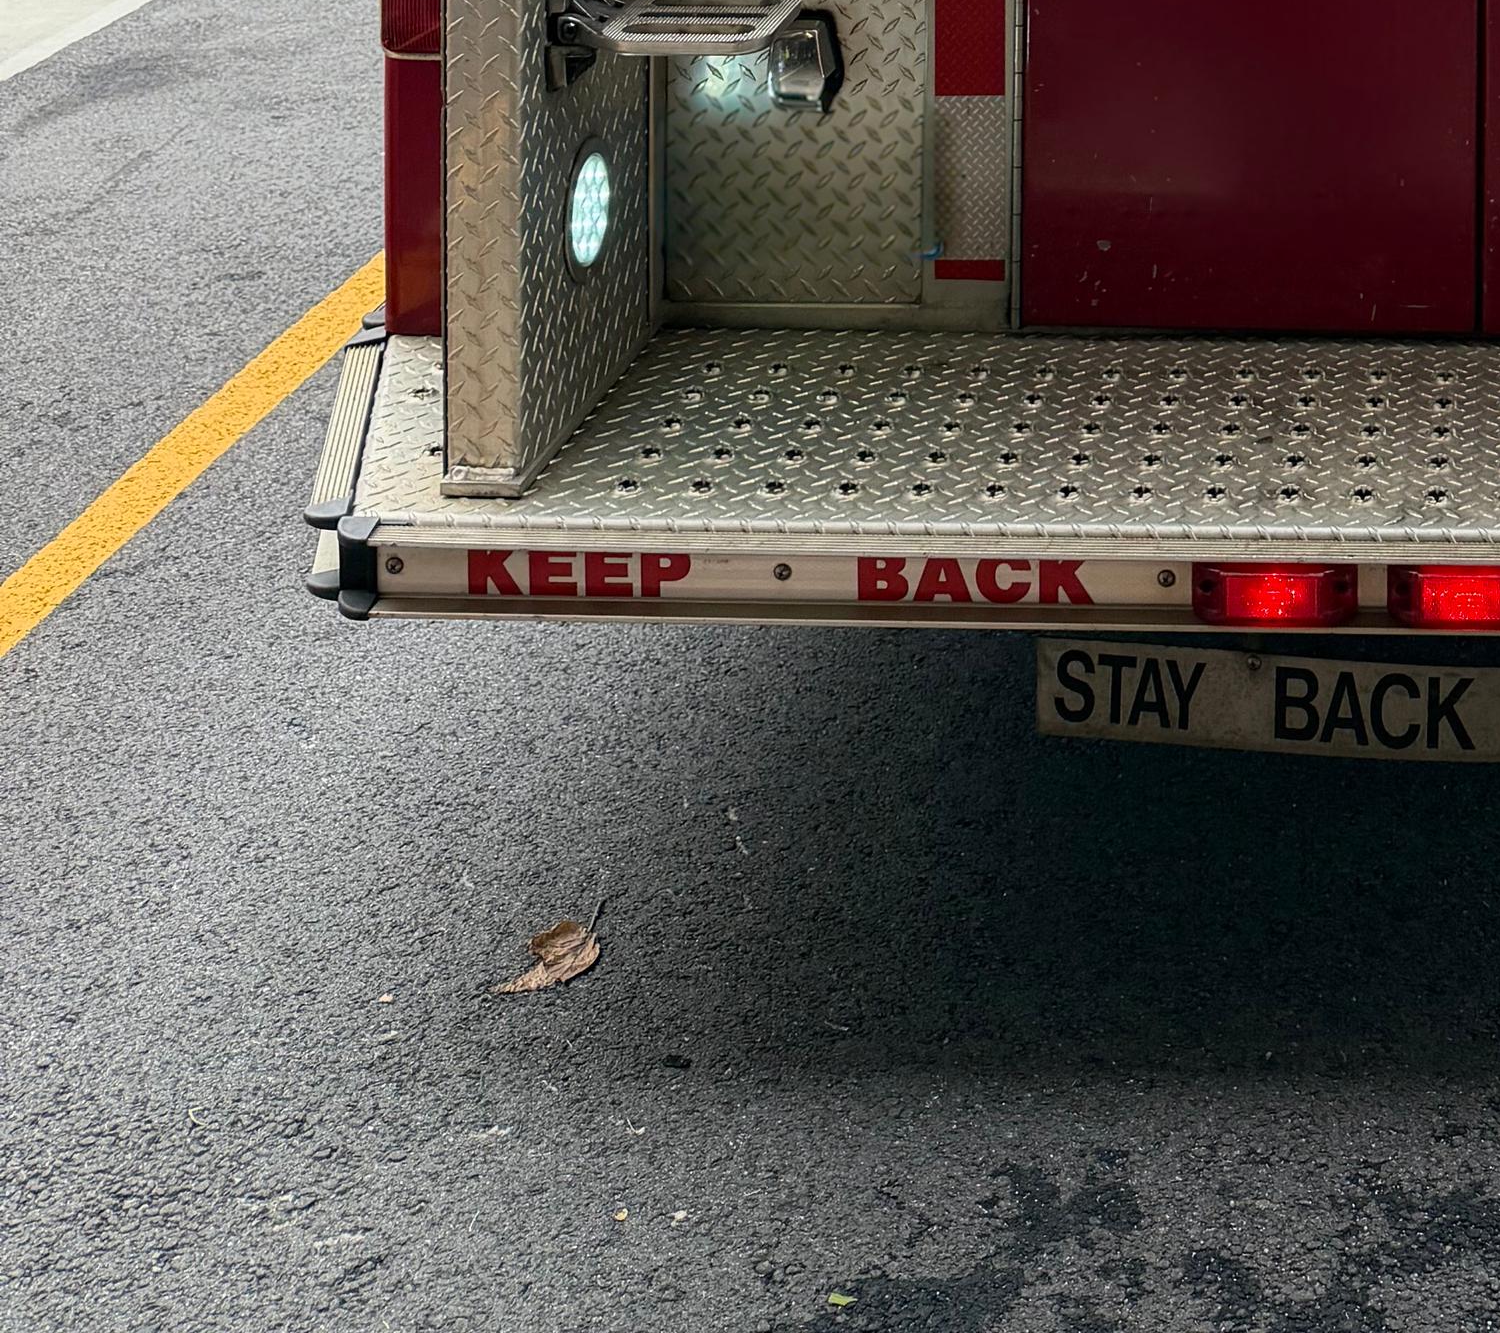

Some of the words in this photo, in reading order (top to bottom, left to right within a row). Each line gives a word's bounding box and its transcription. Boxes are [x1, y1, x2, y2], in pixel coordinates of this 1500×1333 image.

[468, 551, 691, 597] KEEP
[858, 557, 1095, 605] BACK
[1055, 650, 1206, 731] STAY
[1275, 667, 1476, 750] BACK
